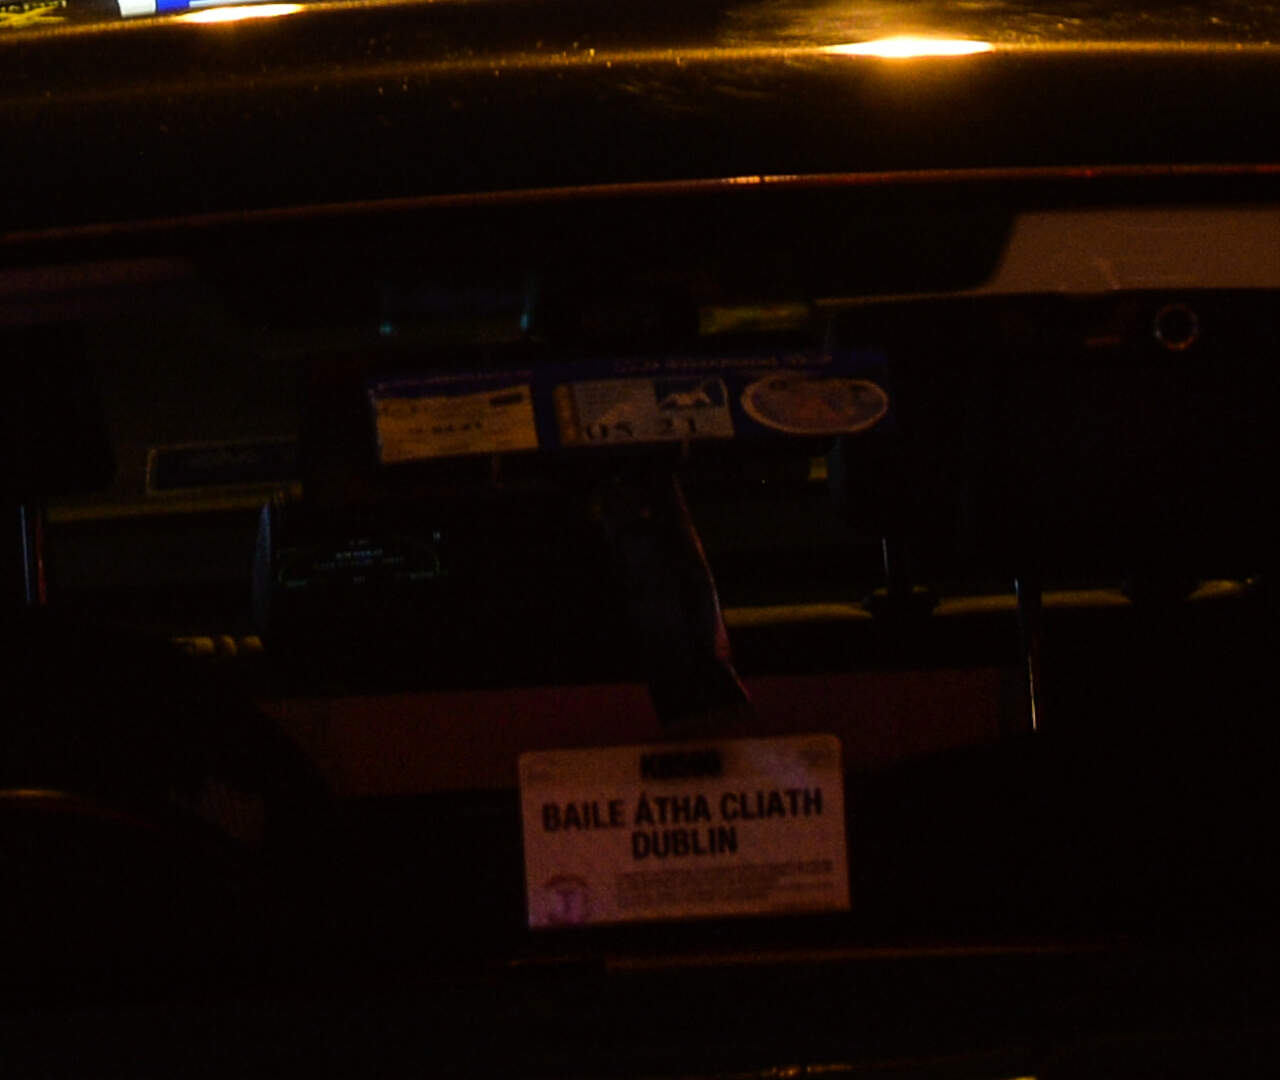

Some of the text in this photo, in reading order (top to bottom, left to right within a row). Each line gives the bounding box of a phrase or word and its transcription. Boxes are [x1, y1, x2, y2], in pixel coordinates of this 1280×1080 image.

[542, 787, 824, 832] BAILE ÁTHA CLIATH
[631, 826, 739, 861] DUBLIN
